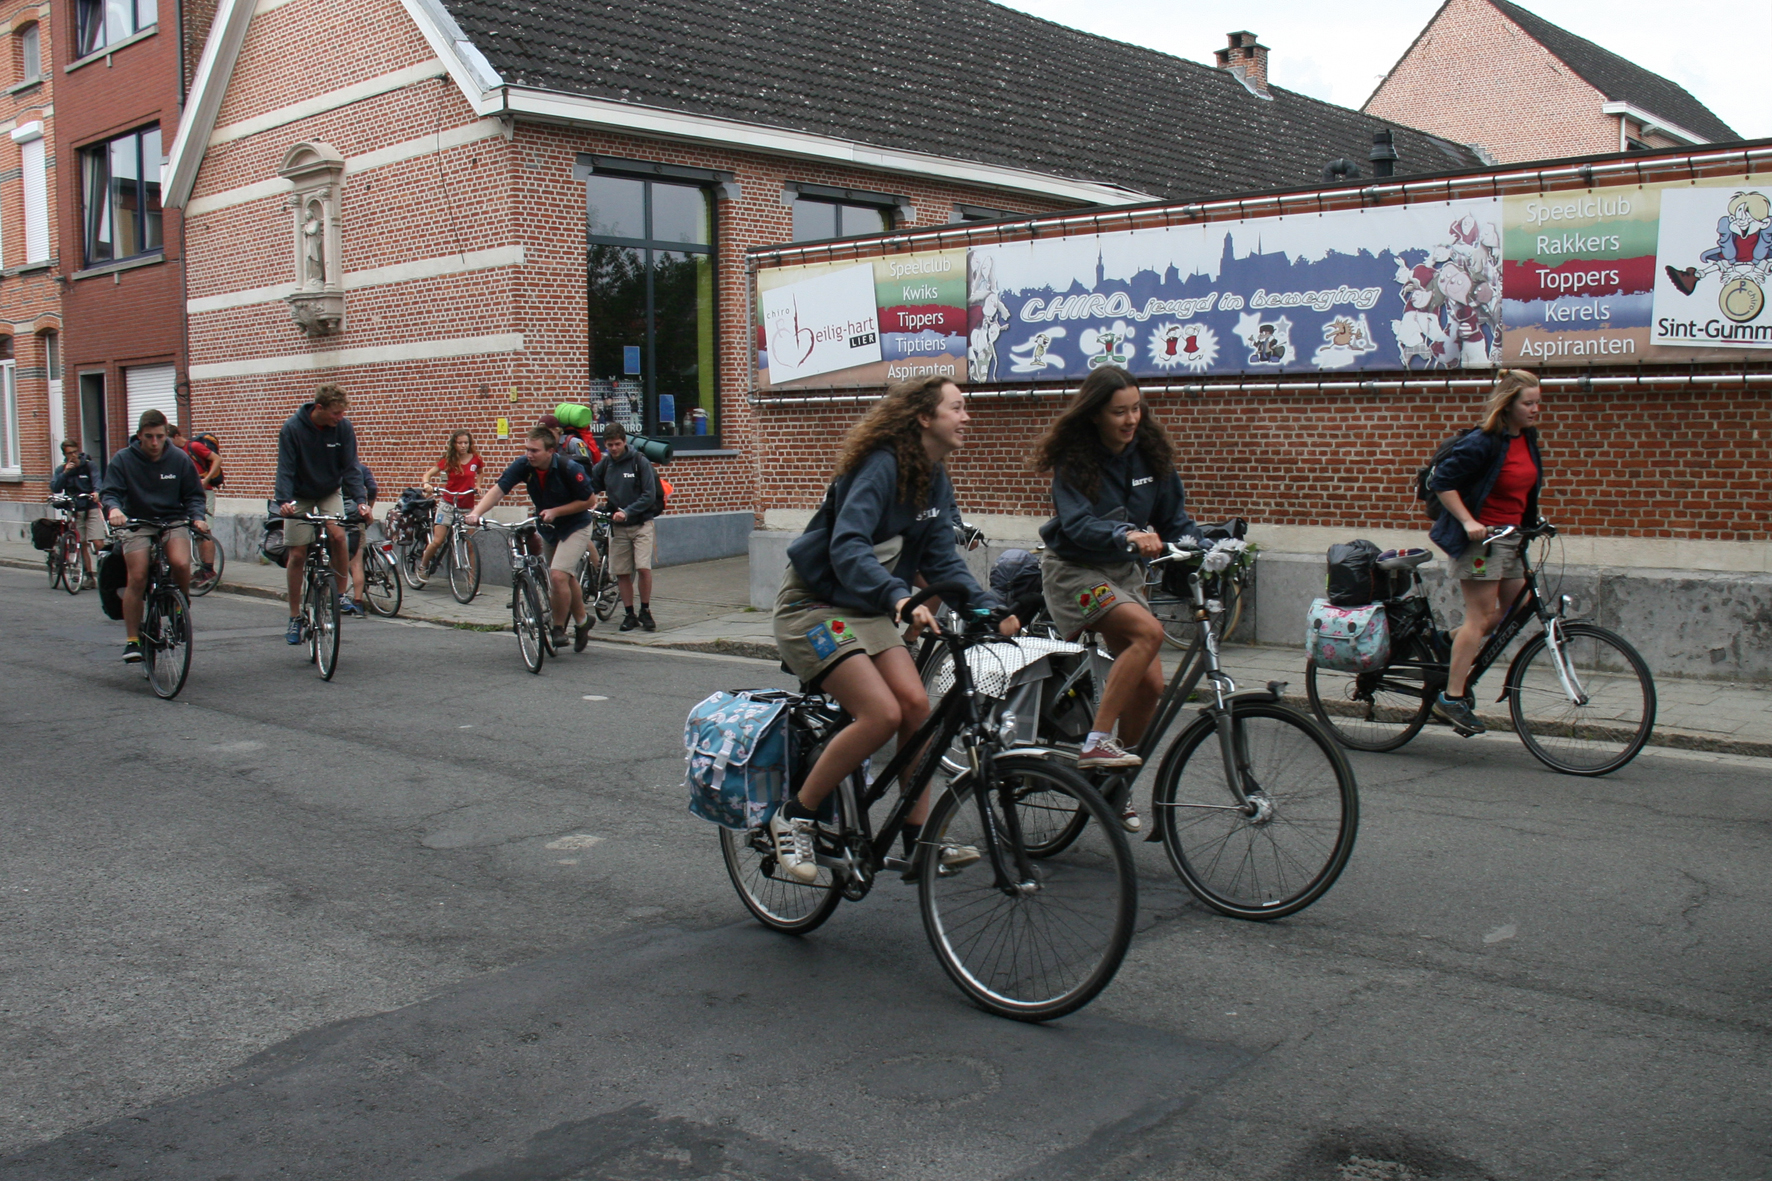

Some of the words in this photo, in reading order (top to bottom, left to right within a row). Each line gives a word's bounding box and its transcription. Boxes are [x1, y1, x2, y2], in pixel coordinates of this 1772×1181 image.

[1526, 195, 1631, 226] Speelclub
[1537, 233, 1620, 255] Rakkers
[889, 256, 951, 279] Speelclub
[1535, 269, 1620, 292] Toppers
[903, 284, 938, 301] Kwiks
[1020, 291, 1136, 322] CHIRO,
[1135, 292, 1218, 322] jeugd
[1218, 292, 1244, 311] in
[1250, 284, 1382, 312] beweging
[1747, 290, 1758, 311] chiro
[767, 308, 790, 319] chiro
[897, 312, 944, 330] Tippers
[1545, 300, 1610, 322] Kerels
[1658, 318, 1772, 339] Sint-Gumm
[851, 334, 875, 347] LIER
[895, 337, 946, 356] Tiptiens
[1519, 336, 1635, 361] Aspiranten
[887, 363, 955, 381] Aspiranten
[589, 423, 610, 433] HIR
